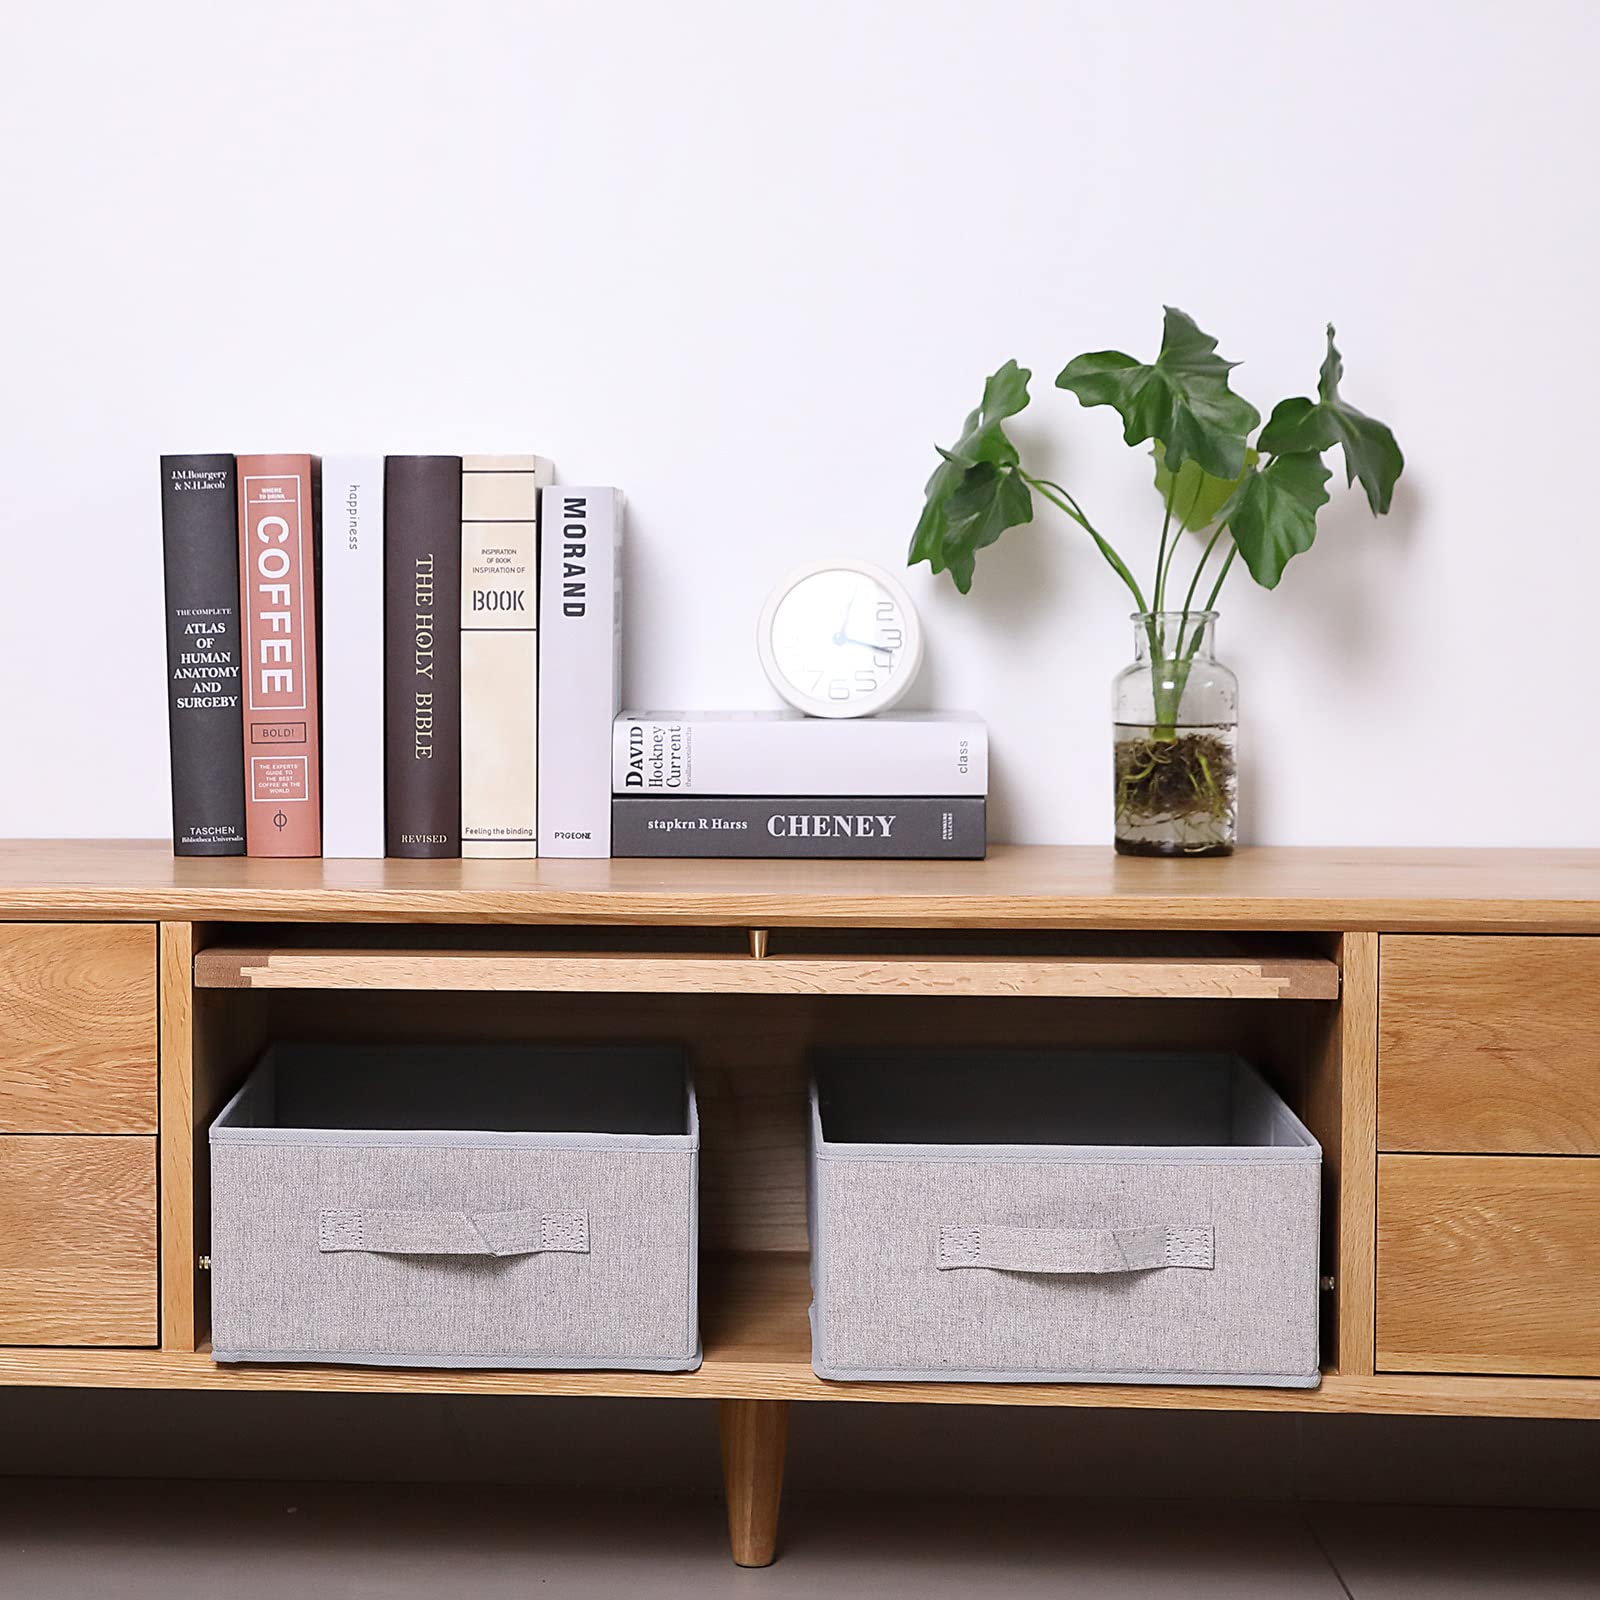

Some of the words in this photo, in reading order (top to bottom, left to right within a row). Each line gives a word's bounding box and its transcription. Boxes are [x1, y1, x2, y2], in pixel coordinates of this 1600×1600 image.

[174, 482, 182, 491] &
[346, 484, 360, 550] happiness
[563, 498, 587, 617] MORAND
[472, 566, 515, 574] INSPIRATION
[415, 553, 434, 606] THE
[256, 515, 293, 693] COFFEE
[472, 590, 525, 611] BOOK
[192, 608, 232, 616] COMPLETE
[184, 622, 226, 634] ATLAS
[196, 637, 215, 649] OF
[415, 614, 434, 680] HOLY
[181, 652, 231, 664] HUMAN
[173, 666, 240, 679] ANATOMY
[192, 682, 222, 693] AND
[415, 692, 433, 760] BIBLE
[262, 729, 295, 738] BOLD!
[625, 726, 643, 788] DAVID
[649, 726, 666, 788] Hockney
[666, 725, 682, 788] Current
[957, 740, 968, 774] class
[190, 826, 235, 835] TASCHEN
[465, 827, 492, 837] Feeling
[493, 827, 505, 835] the
[506, 827, 533, 836] binding
[648, 818, 696, 832] stapkrn
[699, 819, 709, 829] R
[711, 819, 748, 829] Harss
[767, 815, 896, 838] CHENEY
[401, 834, 448, 843] REVISED
